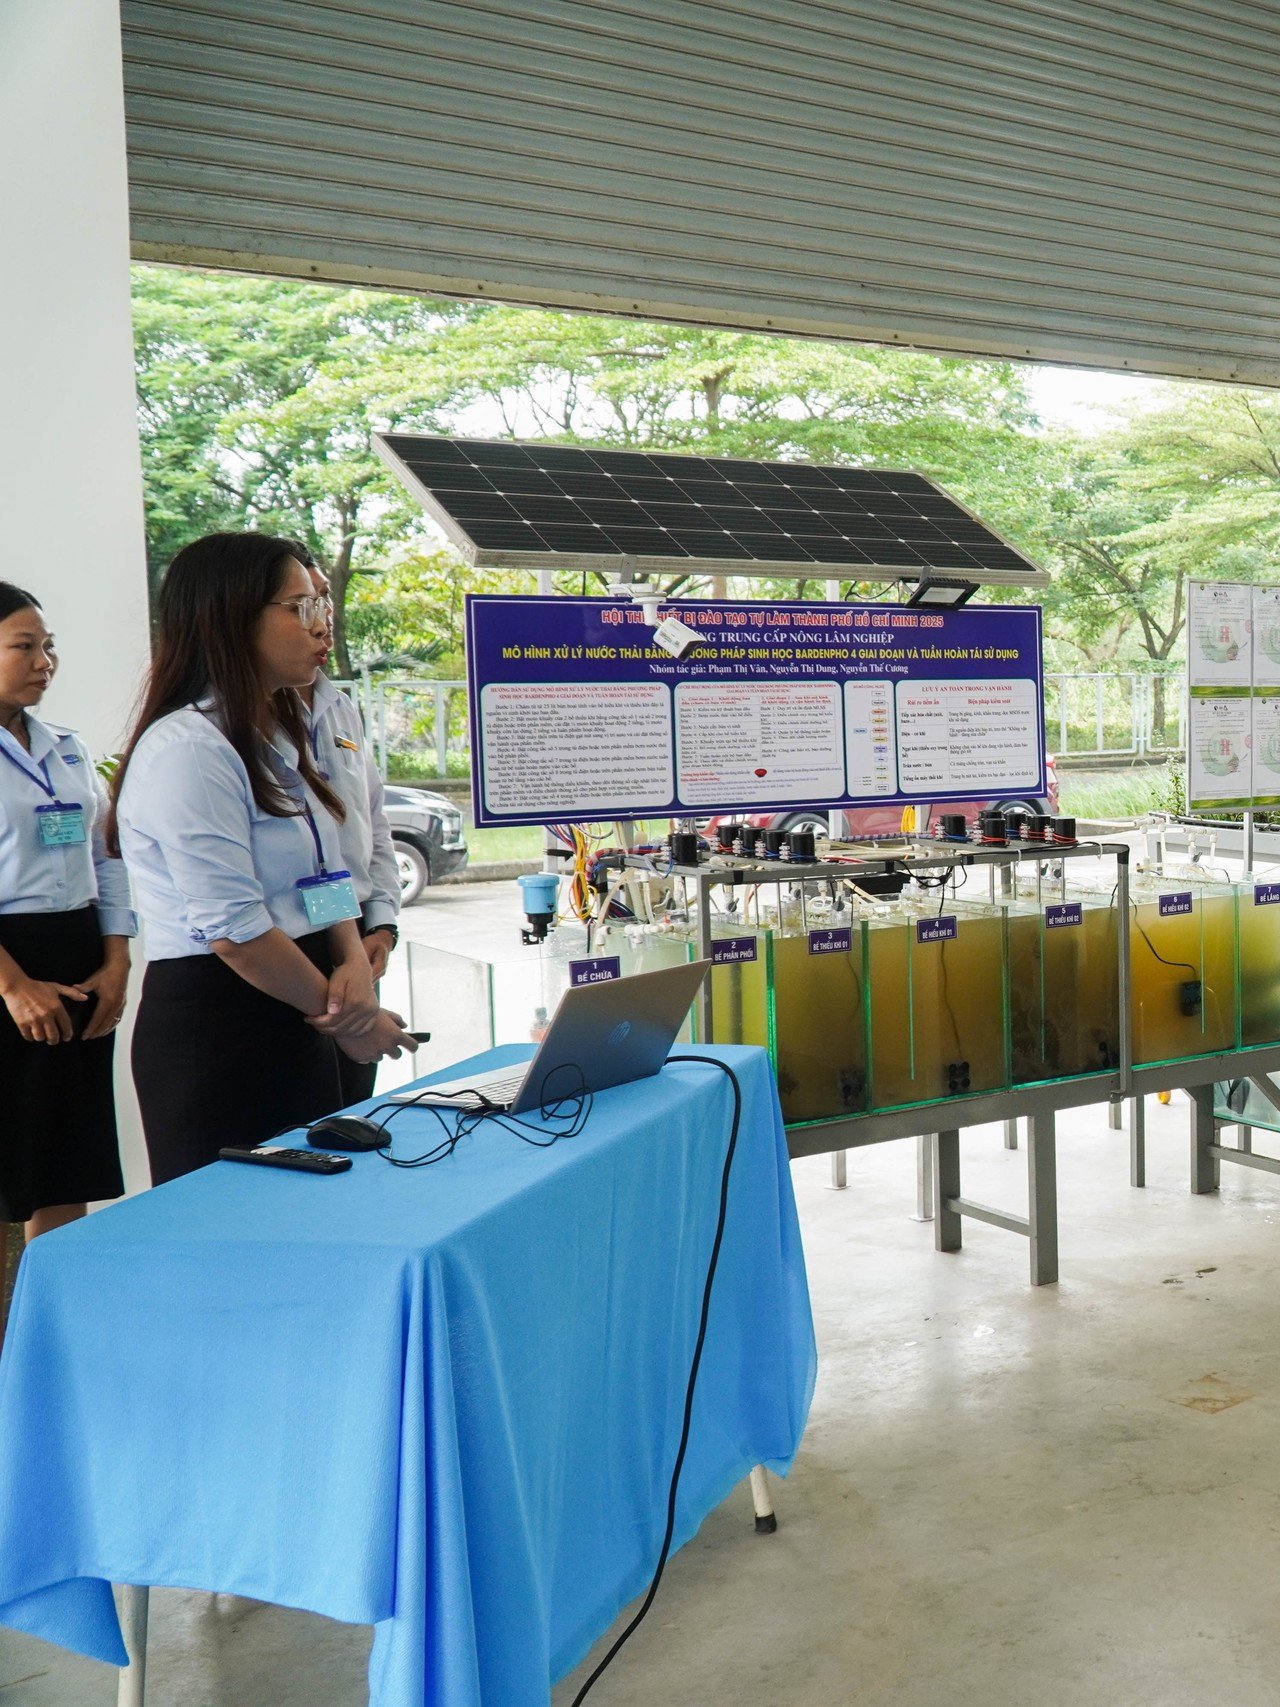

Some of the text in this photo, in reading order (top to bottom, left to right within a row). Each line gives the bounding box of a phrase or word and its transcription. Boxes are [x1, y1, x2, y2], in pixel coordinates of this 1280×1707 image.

[602, 608, 623, 626] HỘI
[656, 607, 682, 622] HIẾT
[684, 611, 696, 628] BỊ
[698, 610, 722, 624] ĐÀO
[725, 612, 747, 628] TẠO
[750, 612, 765, 628] TỰ
[766, 610, 790, 626] LÀM
[792, 611, 828, 626] THÀNH
[831, 610, 853, 626] PHỐ
[855, 611, 870, 626] HỒ
[872, 612, 889, 627] CHÍ
[892, 614, 918, 627] MINH
[920, 615, 944, 628] 2025
[719, 632, 760, 643] TRUNG
[764, 628, 787, 643] CẤP
[790, 630, 822, 643] NÔNG
[825, 631, 850, 643] LÂM
[852, 632, 894, 645] NGHIỆP
[502, 644, 521, 659] MÔ
[524, 645, 550, 658] HÌNH
[554, 644, 568, 659] XỬ
[571, 644, 583, 658] LÝ
[586, 645, 617, 659] NƯỚC
[620, 644, 642, 658] THẢI
[721, 646, 746, 659] PHÁP
[748, 649, 769, 659] SINH
[772, 649, 793, 661] HỌC
[796, 649, 848, 659] BARDENPHO
[851, 649, 856, 659] 4
[859, 649, 877, 659] GIAI
[879, 649, 904, 661] ĐOẠN
[908, 647, 918, 659] VÀ
[944, 647, 968, 659] HOÀN
[970, 646, 982, 659] TÁI
[984, 646, 994, 659] SỬ
[996, 649, 1019, 661] DỤNG
[650, 664, 675, 674] Nhóm
[677, 664, 690, 674] tác
[691, 664, 706, 675] giả:
[708, 664, 731, 675] Phạm
[734, 664, 748, 675] Thị
[770, 663, 799, 675] Nguyễn
[801, 664, 814, 675] Thị
[816, 664, 838, 675] Dung,
[840, 662, 868, 675] Nguyễn
[869, 662, 884, 673] Thế
[885, 664, 908, 674] Cương
[590, 970, 612, 981] CHỨA
